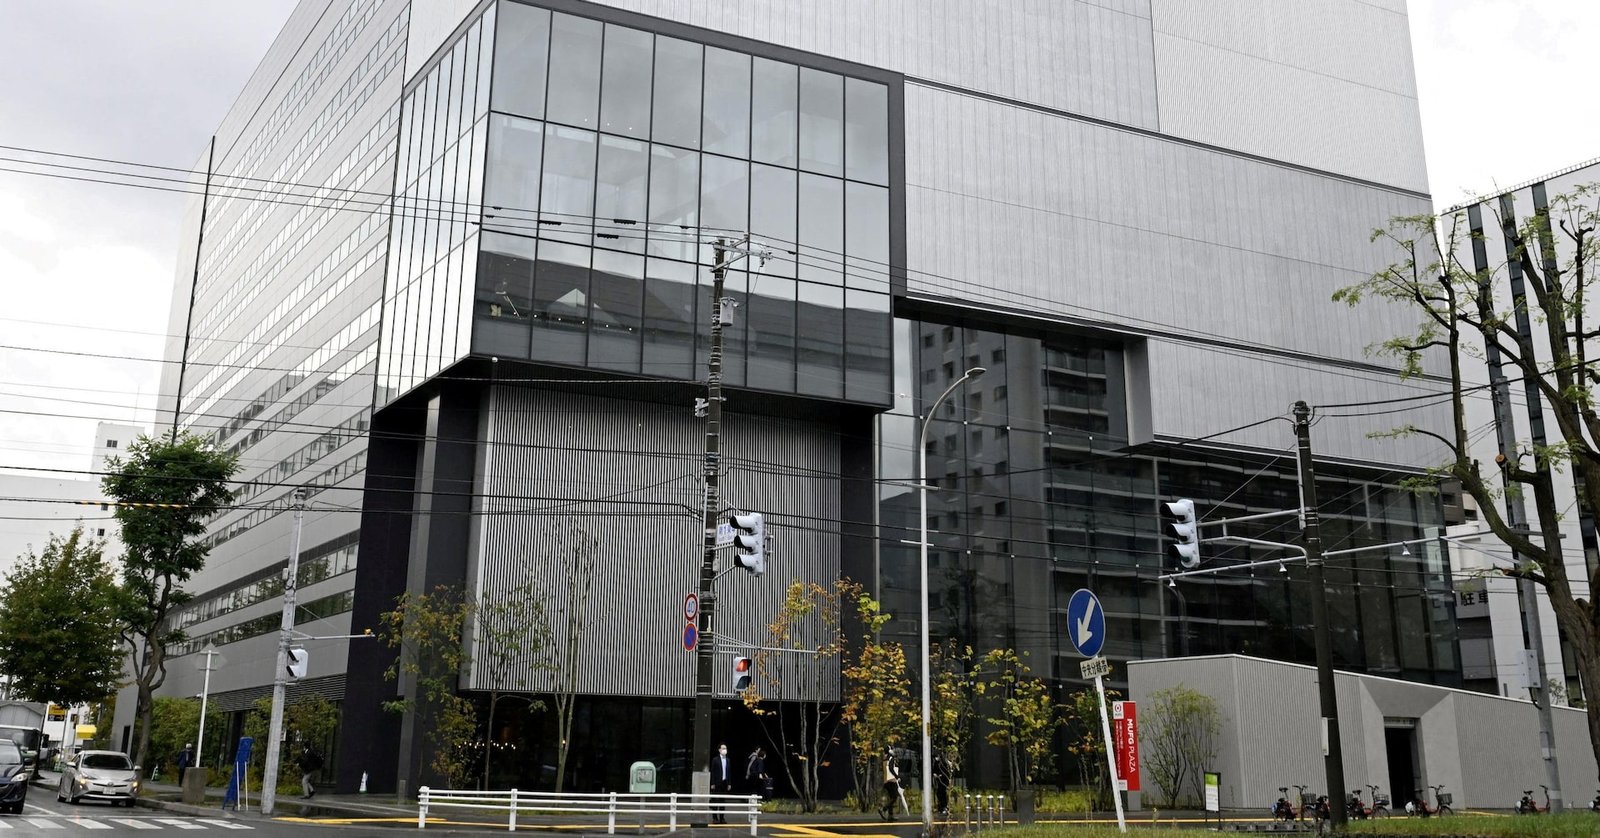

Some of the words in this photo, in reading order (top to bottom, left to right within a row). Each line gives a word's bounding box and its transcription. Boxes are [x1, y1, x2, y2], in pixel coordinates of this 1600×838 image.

[687, 601, 695, 613] 40
[1082, 660, 1107, 677] 中央分離帯
[1127, 718, 1135, 745] MUFG
[1128, 746, 1137, 774] PLAZA
